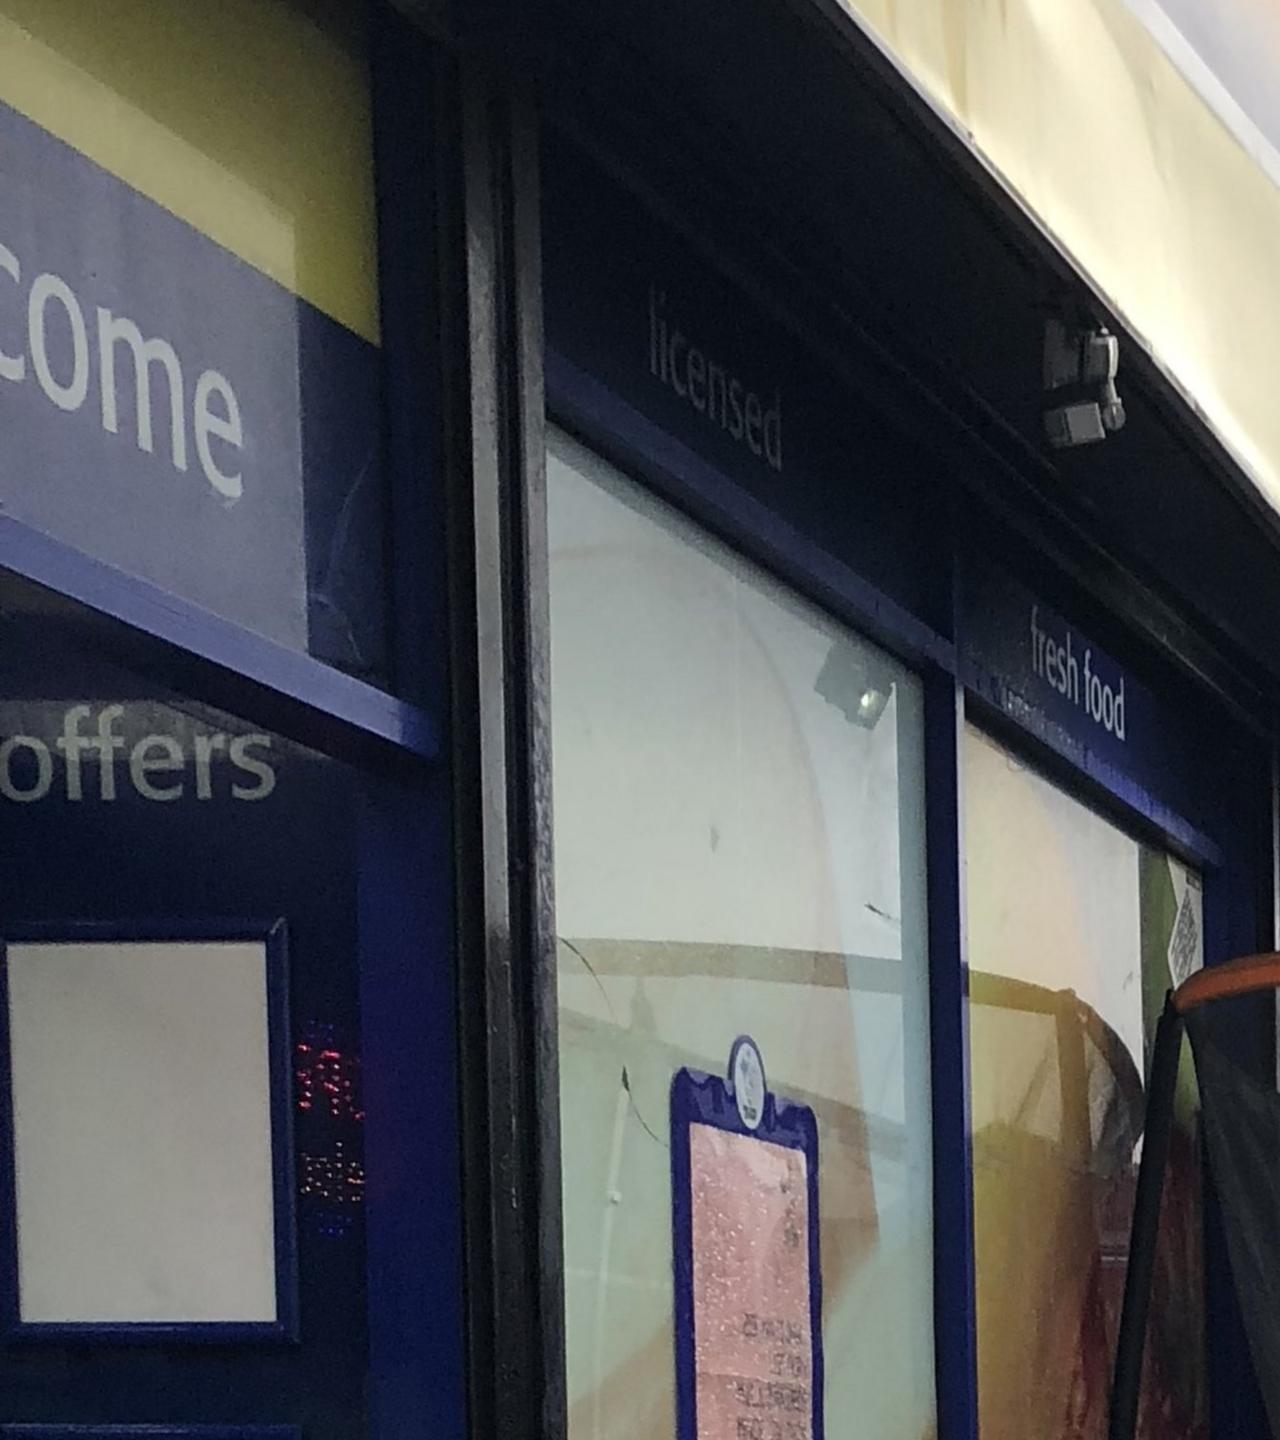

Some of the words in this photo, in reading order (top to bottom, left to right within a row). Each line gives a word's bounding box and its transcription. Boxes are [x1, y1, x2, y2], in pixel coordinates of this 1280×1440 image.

[649, 282, 783, 473] licensed
[1030, 604, 1079, 705] fresh
[1084, 648, 1126, 742] food
[0, 704, 277, 801] offers
